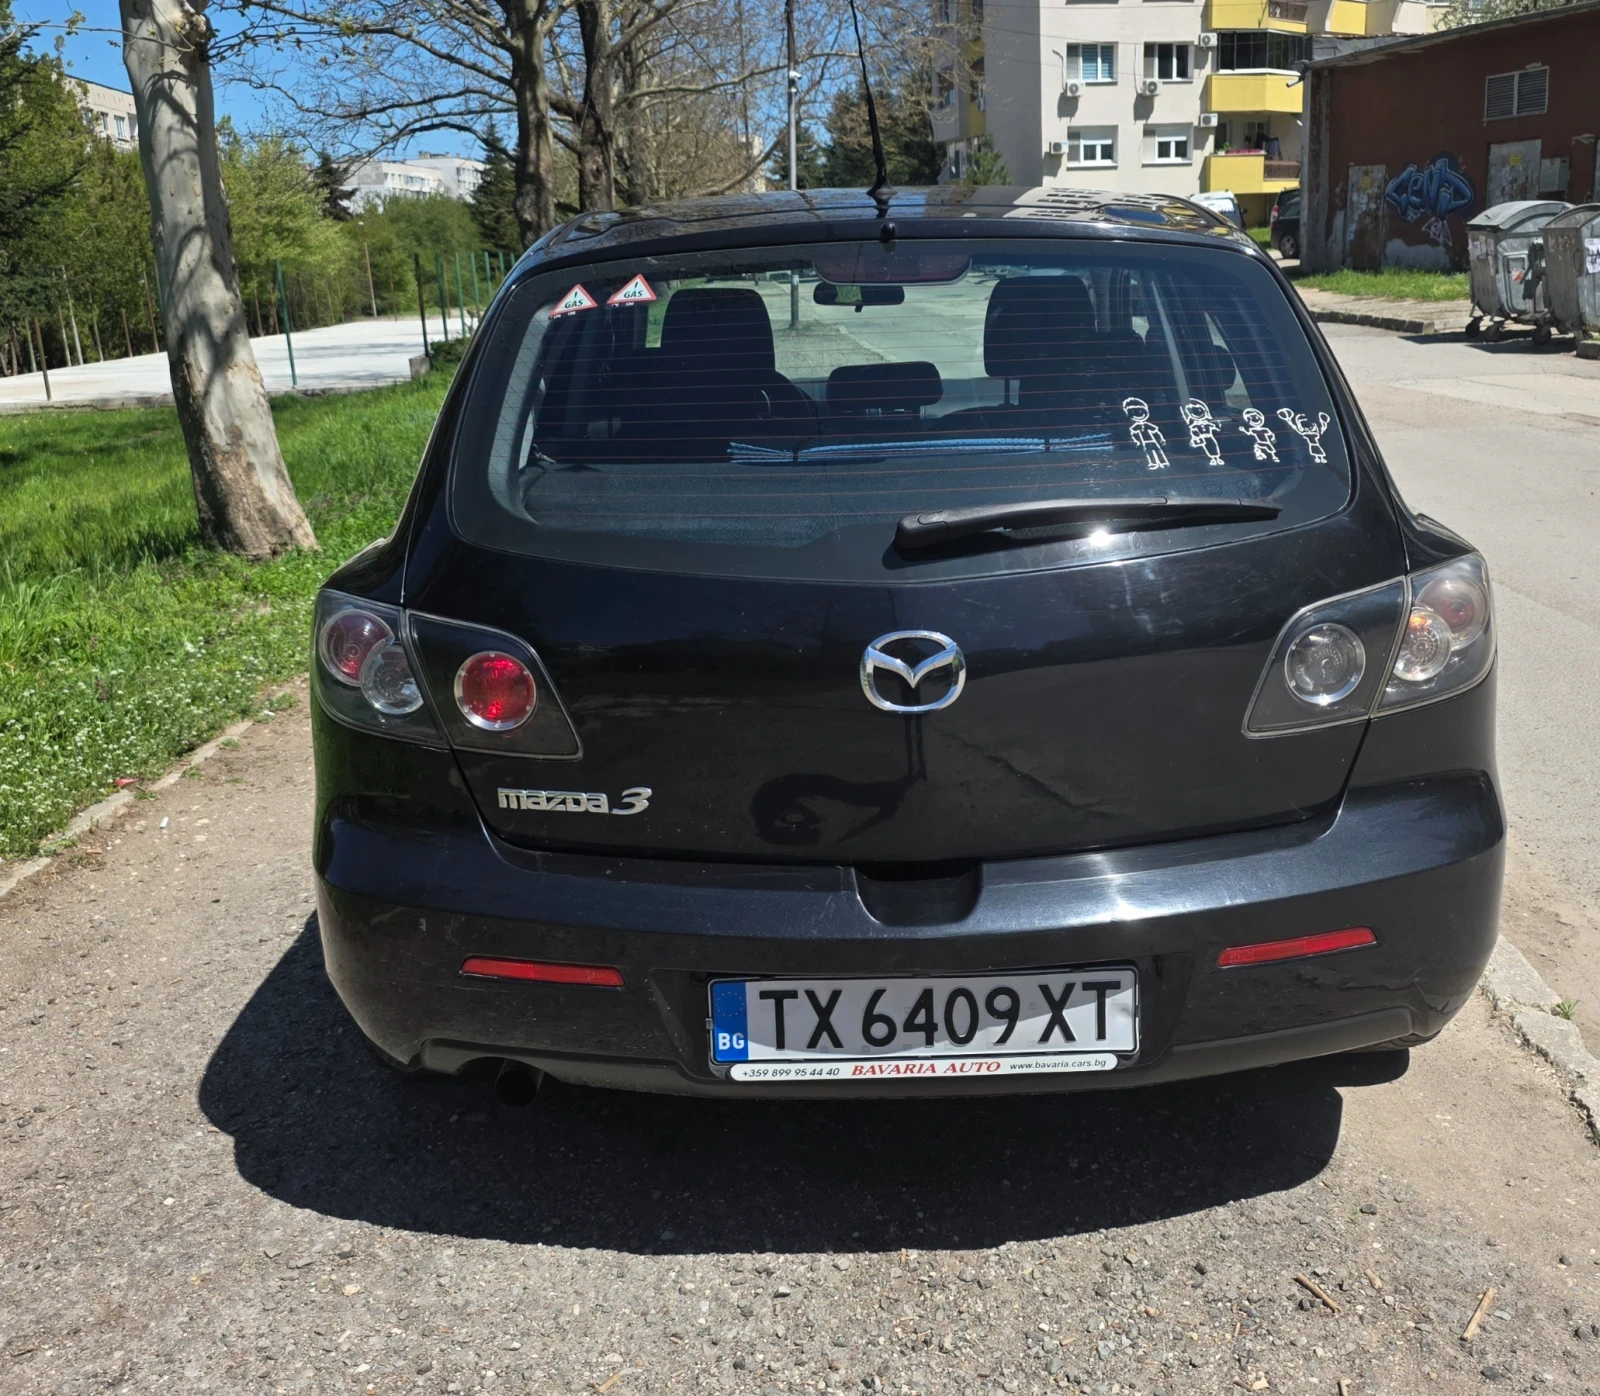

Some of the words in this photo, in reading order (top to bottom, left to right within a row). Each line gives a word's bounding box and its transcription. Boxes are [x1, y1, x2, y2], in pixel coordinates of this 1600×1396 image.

[623, 290, 643, 299] GAS
[564, 299, 584, 309] GAS
[611, 786, 653, 815] 3
[759, 989, 844, 1050] TX
[862, 986, 1021, 1047] 6409
[1037, 980, 1121, 1044] XT
[718, 1032, 745, 1050] BG
[742, 1069, 769, 1078] +359
[771, 1069, 792, 1077] 899
[794, 1069, 807, 1077] 95
[809, 1068, 823, 1077] 44
[825, 1068, 840, 1077] 40
[851, 1063, 936, 1076] BAVARIA
[943, 1061, 1001, 1074] AUTO
[1010, 1059, 1107, 1071] www.bavaria.cars.bg
